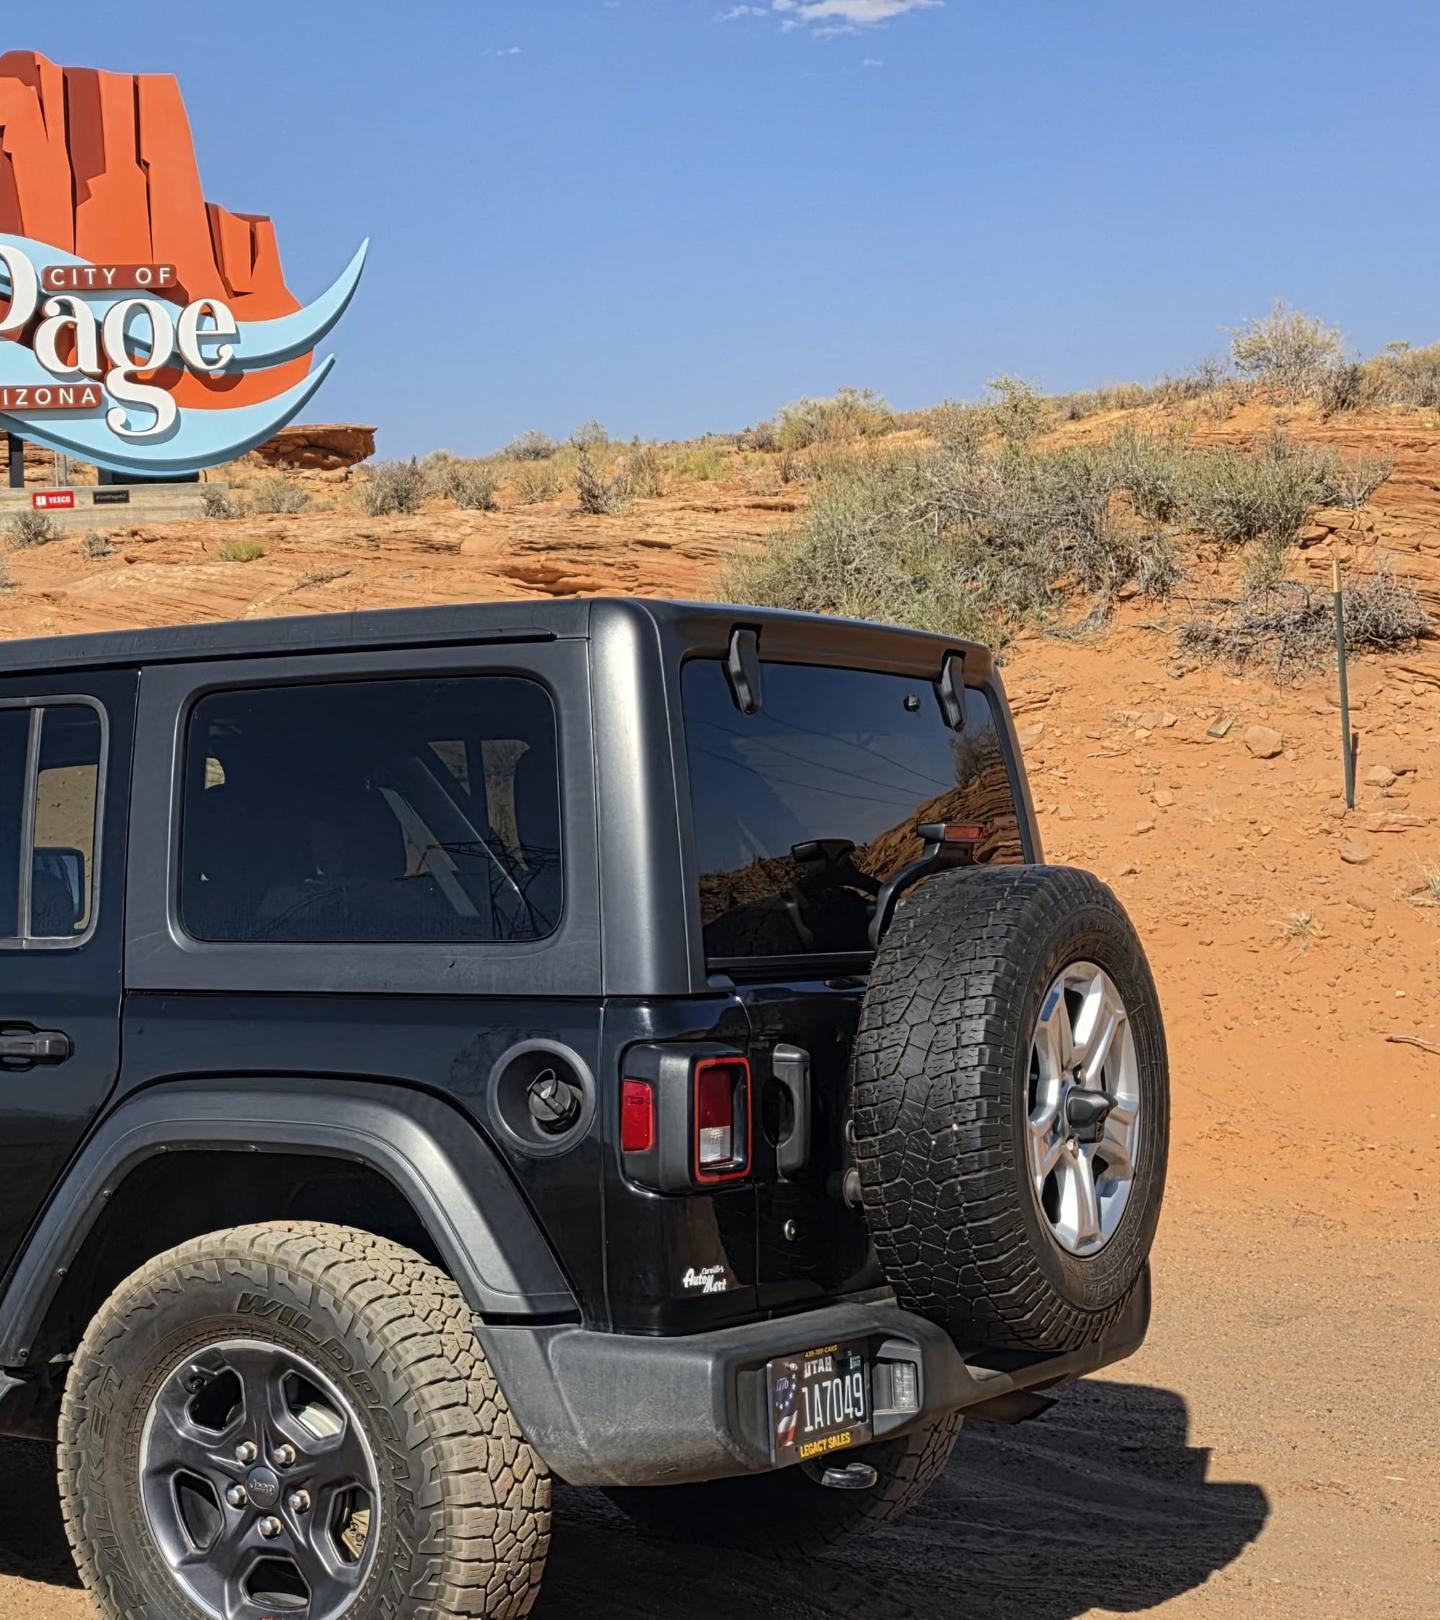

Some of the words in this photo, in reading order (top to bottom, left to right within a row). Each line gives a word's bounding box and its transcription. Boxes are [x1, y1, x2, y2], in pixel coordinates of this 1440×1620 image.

[50, 268, 116, 285] CITY
[135, 267, 171, 284] OF
[48, 495, 71, 504] YESCO
[683, 1268, 708, 1288] Auto
[703, 1274, 726, 1293] Mart
[804, 1355, 833, 1378] UTAH
[802, 1373, 864, 1432] 1A7049
[800, 1438, 827, 1458] LEGACY
[827, 1432, 851, 1449] SALES
